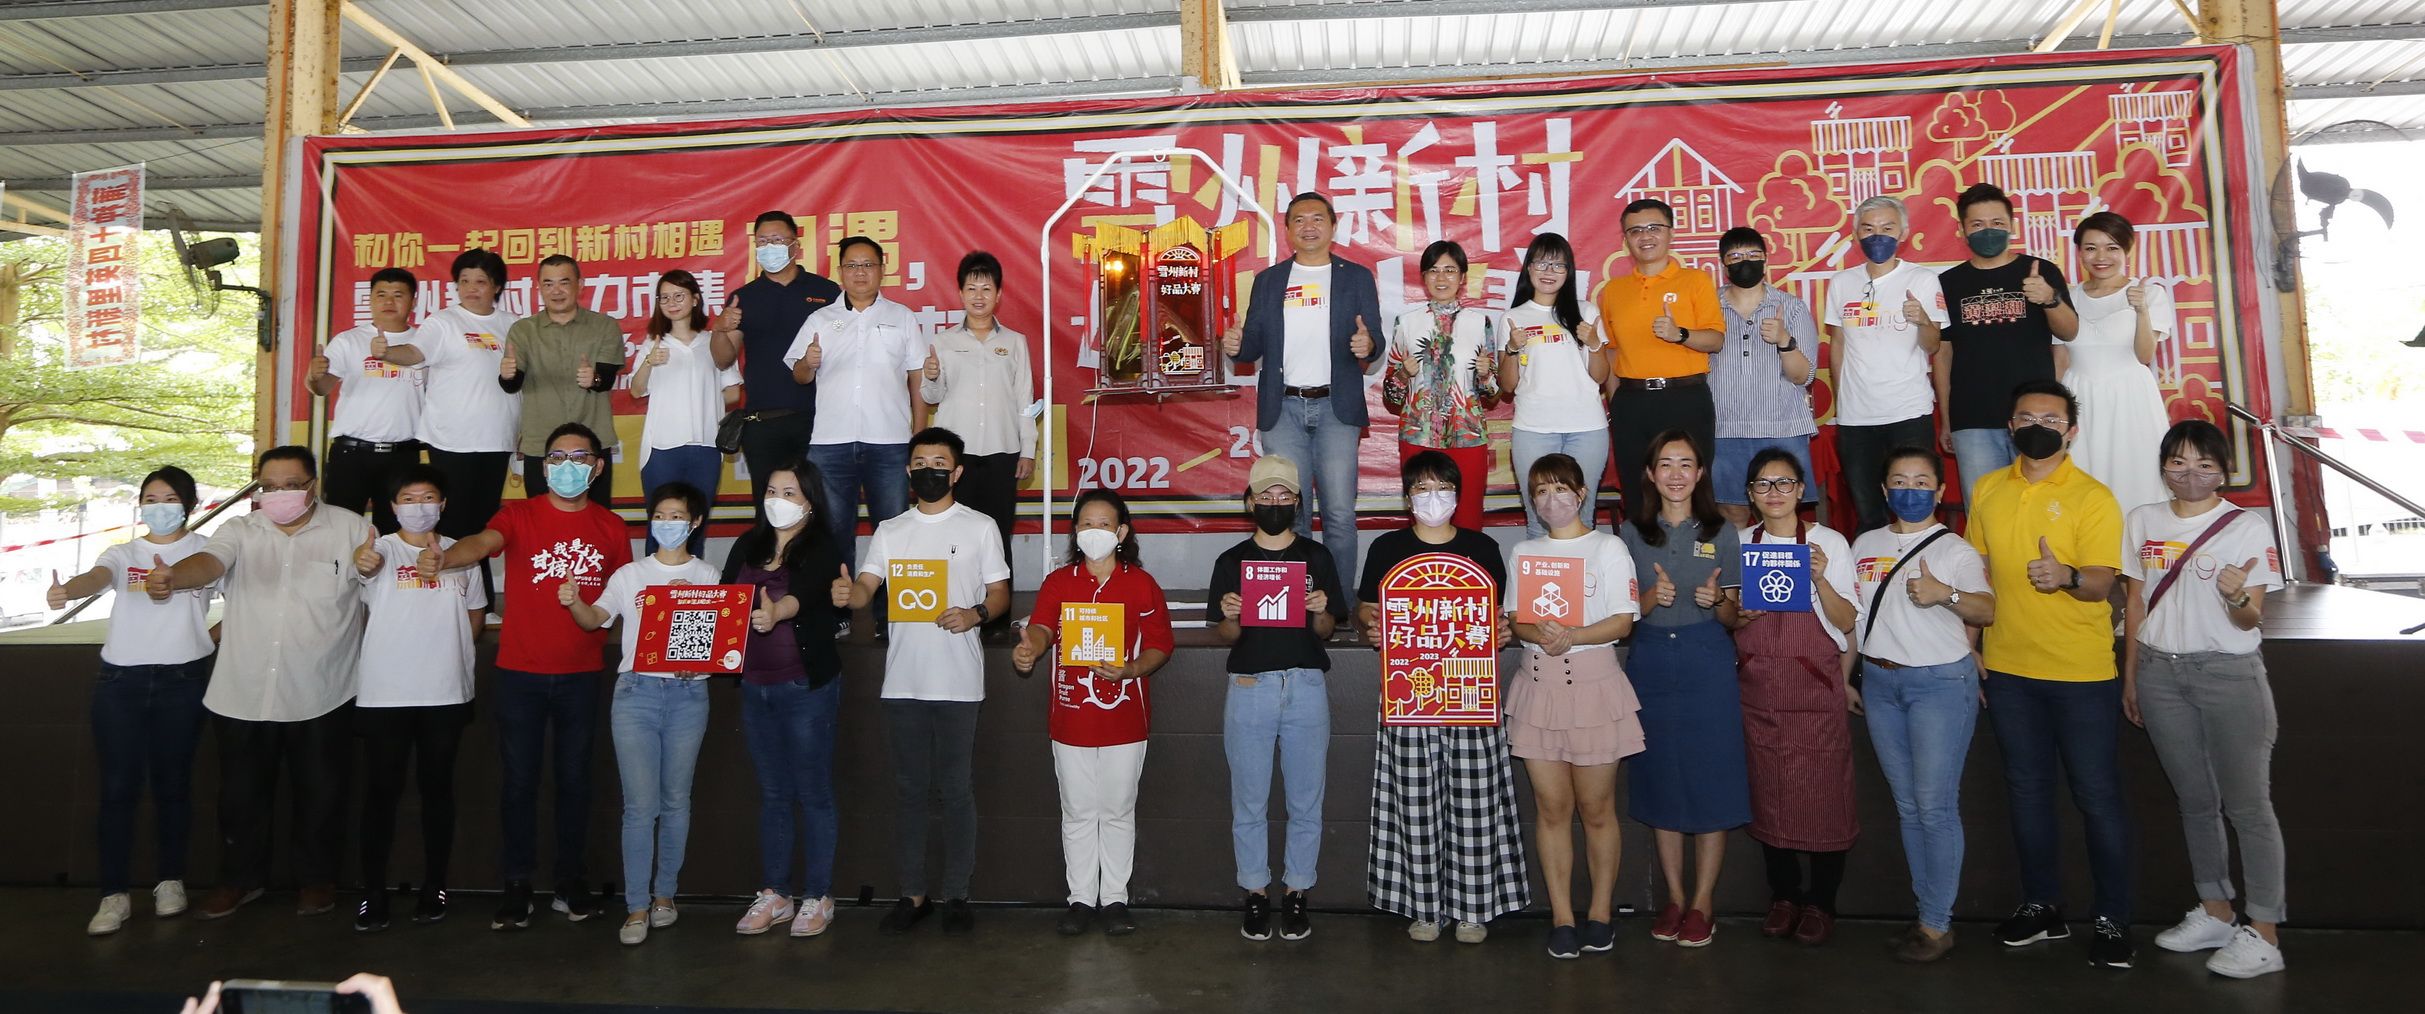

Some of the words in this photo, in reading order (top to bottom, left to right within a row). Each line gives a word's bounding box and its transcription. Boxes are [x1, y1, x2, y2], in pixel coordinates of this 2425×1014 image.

[1064, 117, 1584, 259] 雪州新村
[353, 219, 725, 269] 和你一起回到新村相遇
[1157, 265, 1199, 278] 雪州新村
[1077, 456, 1170, 489] 2022
[553, 538, 589, 559] 我是
[1742, 551, 1760, 566] 17
[891, 563, 904, 577] 12
[1245, 566, 1254, 580] 8
[1522, 560, 1531, 575] 9
[1064, 608, 1075, 621] 11
[1386, 597, 1488, 625] 雪州新村
[1389, 625, 1490, 650] 好品大賽
[1390, 658, 1409, 667] 2022
[1419, 652, 1439, 661] 2023
